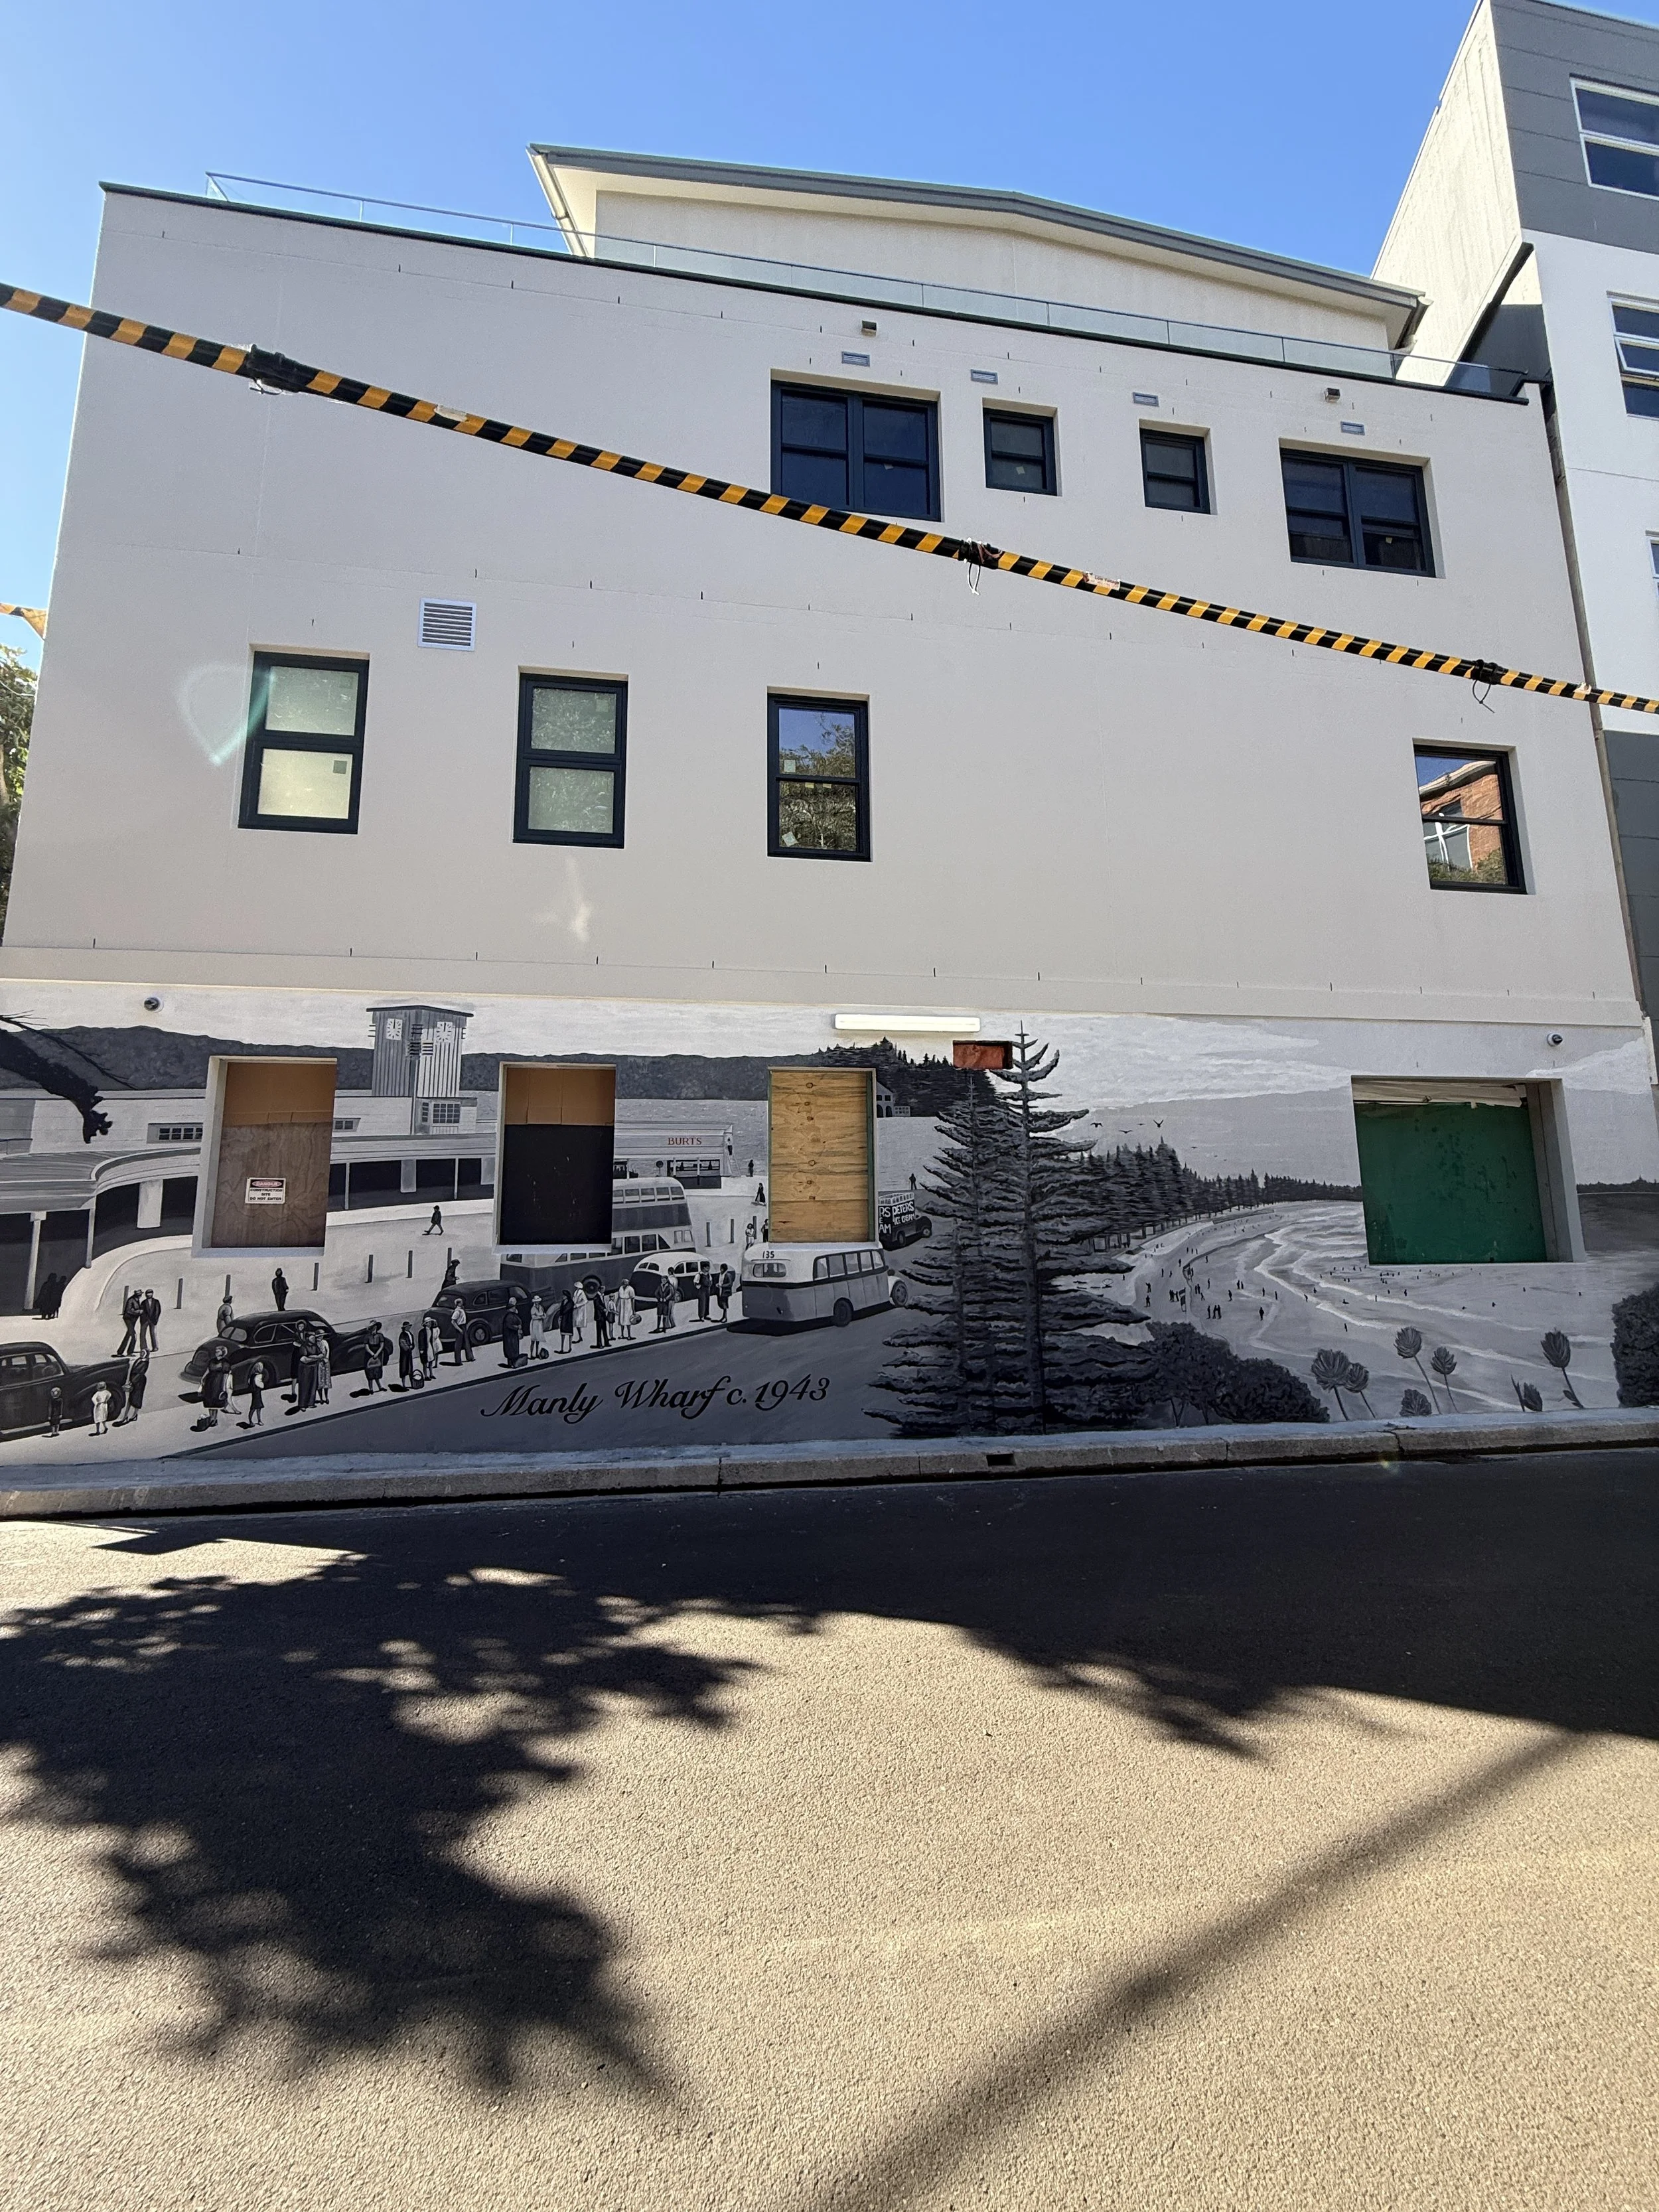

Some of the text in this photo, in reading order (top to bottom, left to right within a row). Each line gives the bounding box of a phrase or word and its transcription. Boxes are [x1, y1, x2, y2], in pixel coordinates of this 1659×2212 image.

[892, 1201, 914, 1222] PETERS
[480, 1373, 830, 1424] Manly Wharf c. 1943
